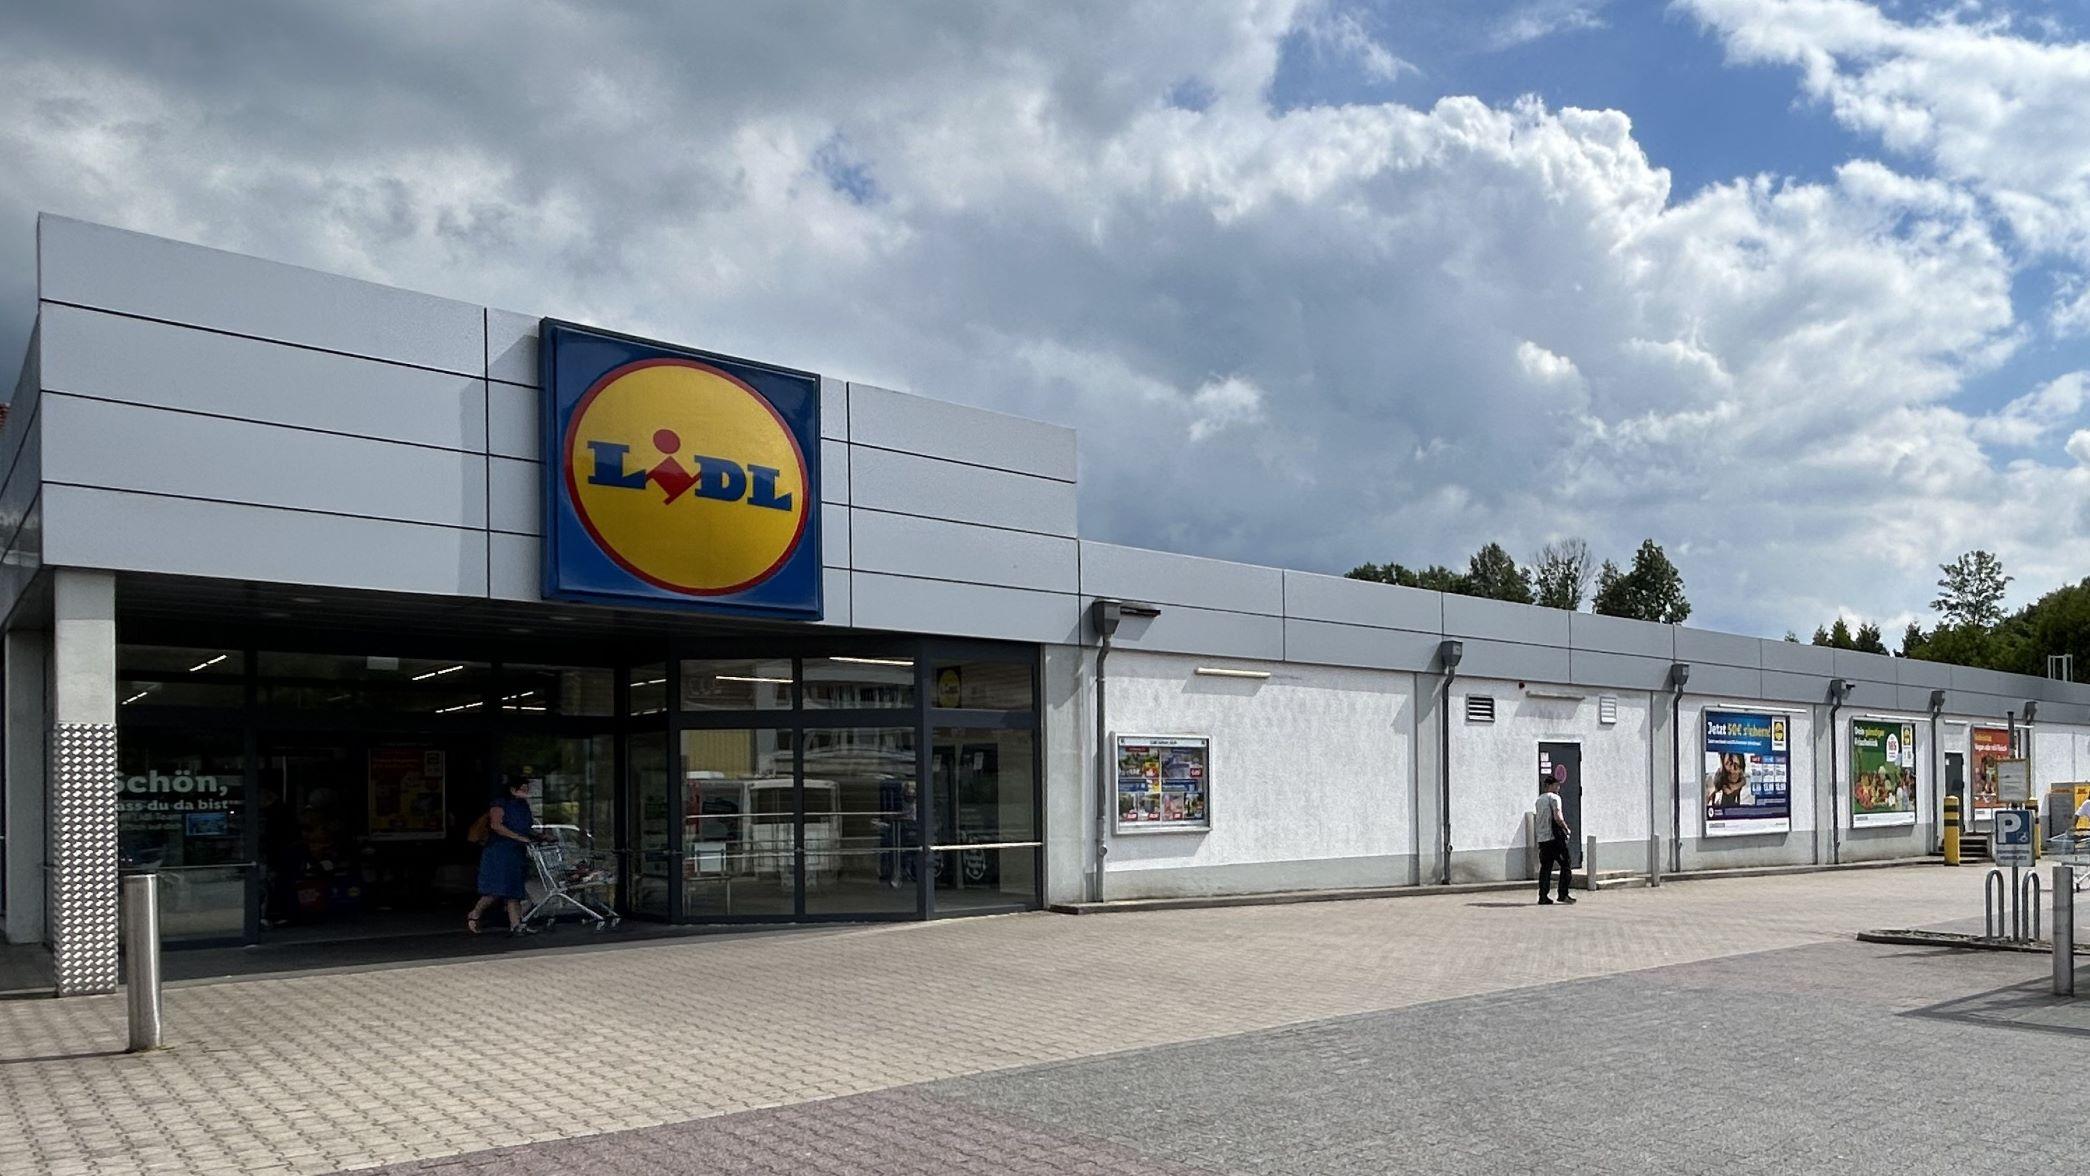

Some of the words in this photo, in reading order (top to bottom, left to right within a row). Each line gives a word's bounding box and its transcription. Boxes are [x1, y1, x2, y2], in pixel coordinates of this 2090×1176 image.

[117, 800, 144, 812] ass
[147, 799, 169, 811] du
[173, 799, 195, 811] da
[198, 797, 228, 810] bist
[1996, 813, 2022, 844] P
